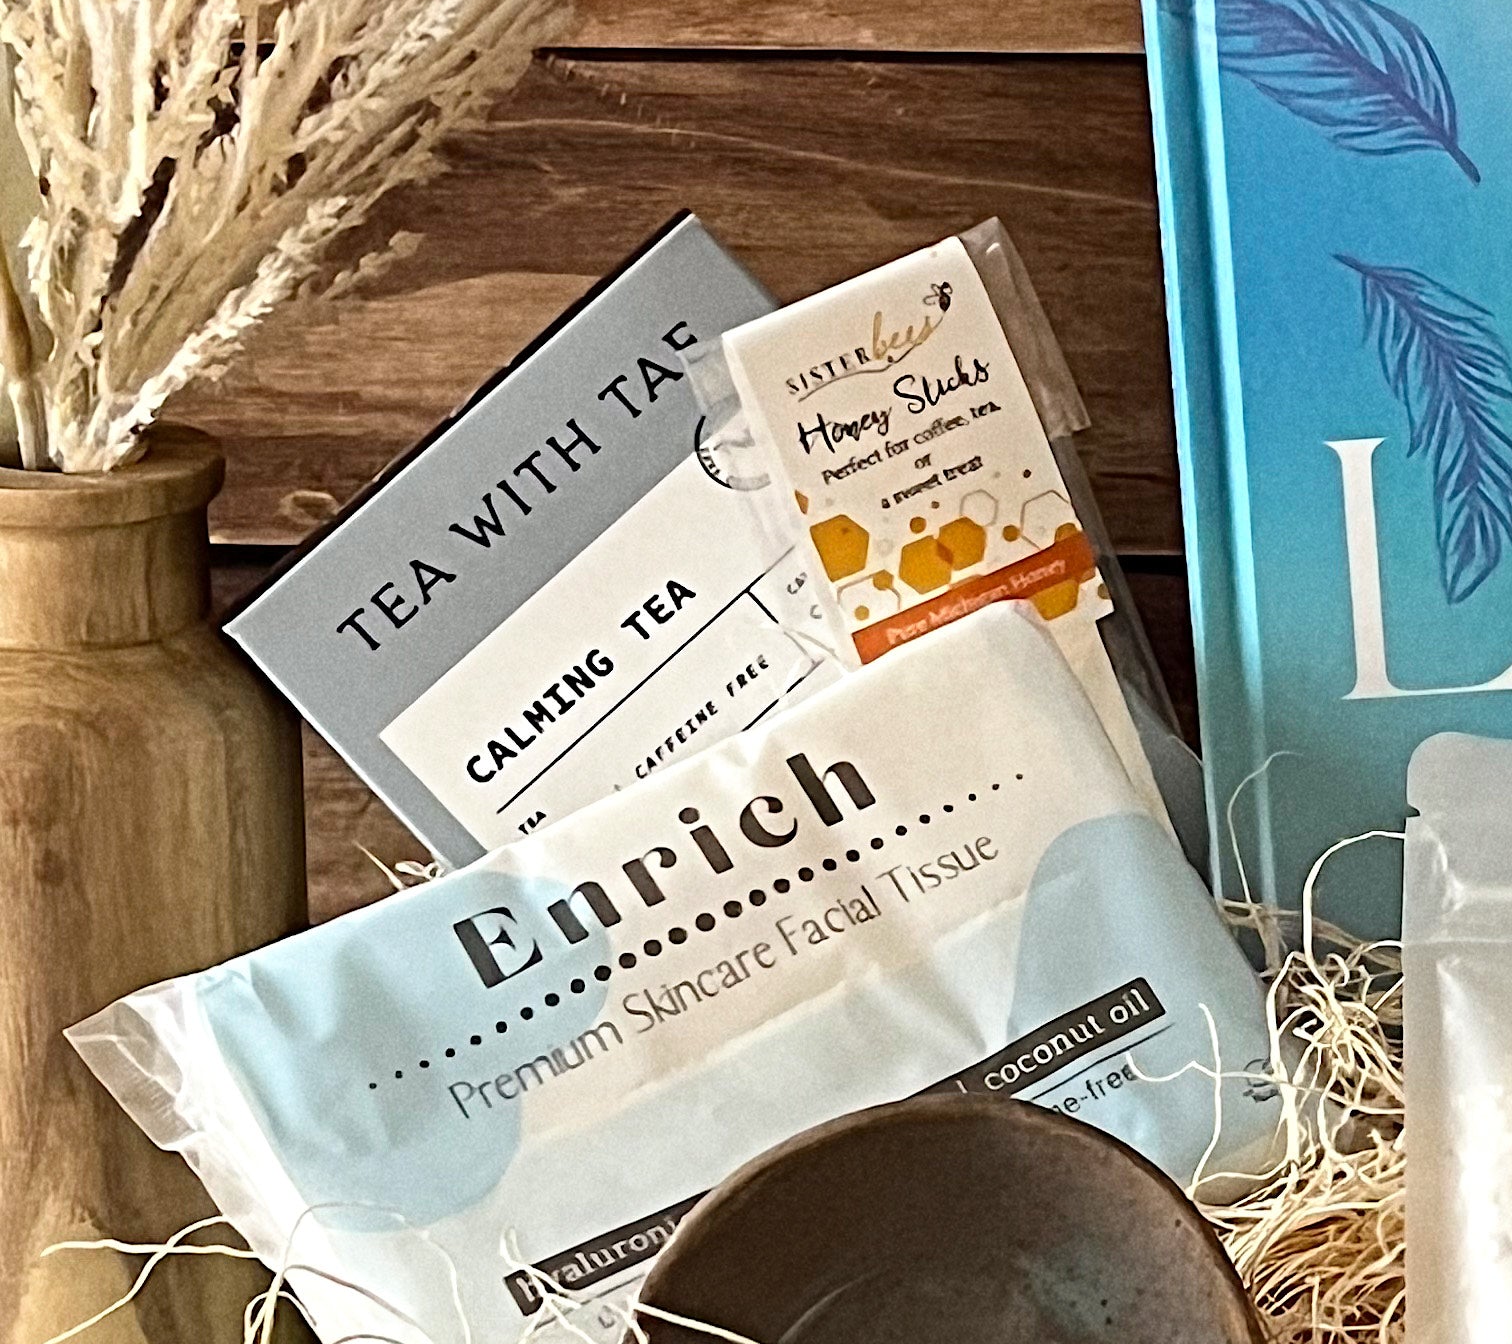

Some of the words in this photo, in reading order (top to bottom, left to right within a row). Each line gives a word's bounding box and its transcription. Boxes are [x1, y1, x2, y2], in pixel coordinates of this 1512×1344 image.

[797, 406, 892, 455] Honey
[893, 355, 990, 414] Sticks
[821, 450, 882, 485] Perfect
[884, 439, 910, 458] for
[915, 454, 932, 469] or
[336, 559, 457, 653] TEA
[449, 418, 602, 552] WITH
[466, 649, 615, 785] CALMING
[620, 580, 697, 640] TEA
[635, 701, 719, 779] CAFFEINE
[726, 654, 770, 697] FREE
[450, 751, 880, 989] Enrich
[446, 1017, 624, 1121] Premium
[622, 934, 778, 1038] Skincare
[779, 885, 883, 974] Facial
[877, 830, 1002, 913] Tissue
[984, 1015, 1106, 1091] coconut
[1109, 988, 1151, 1025] oil
